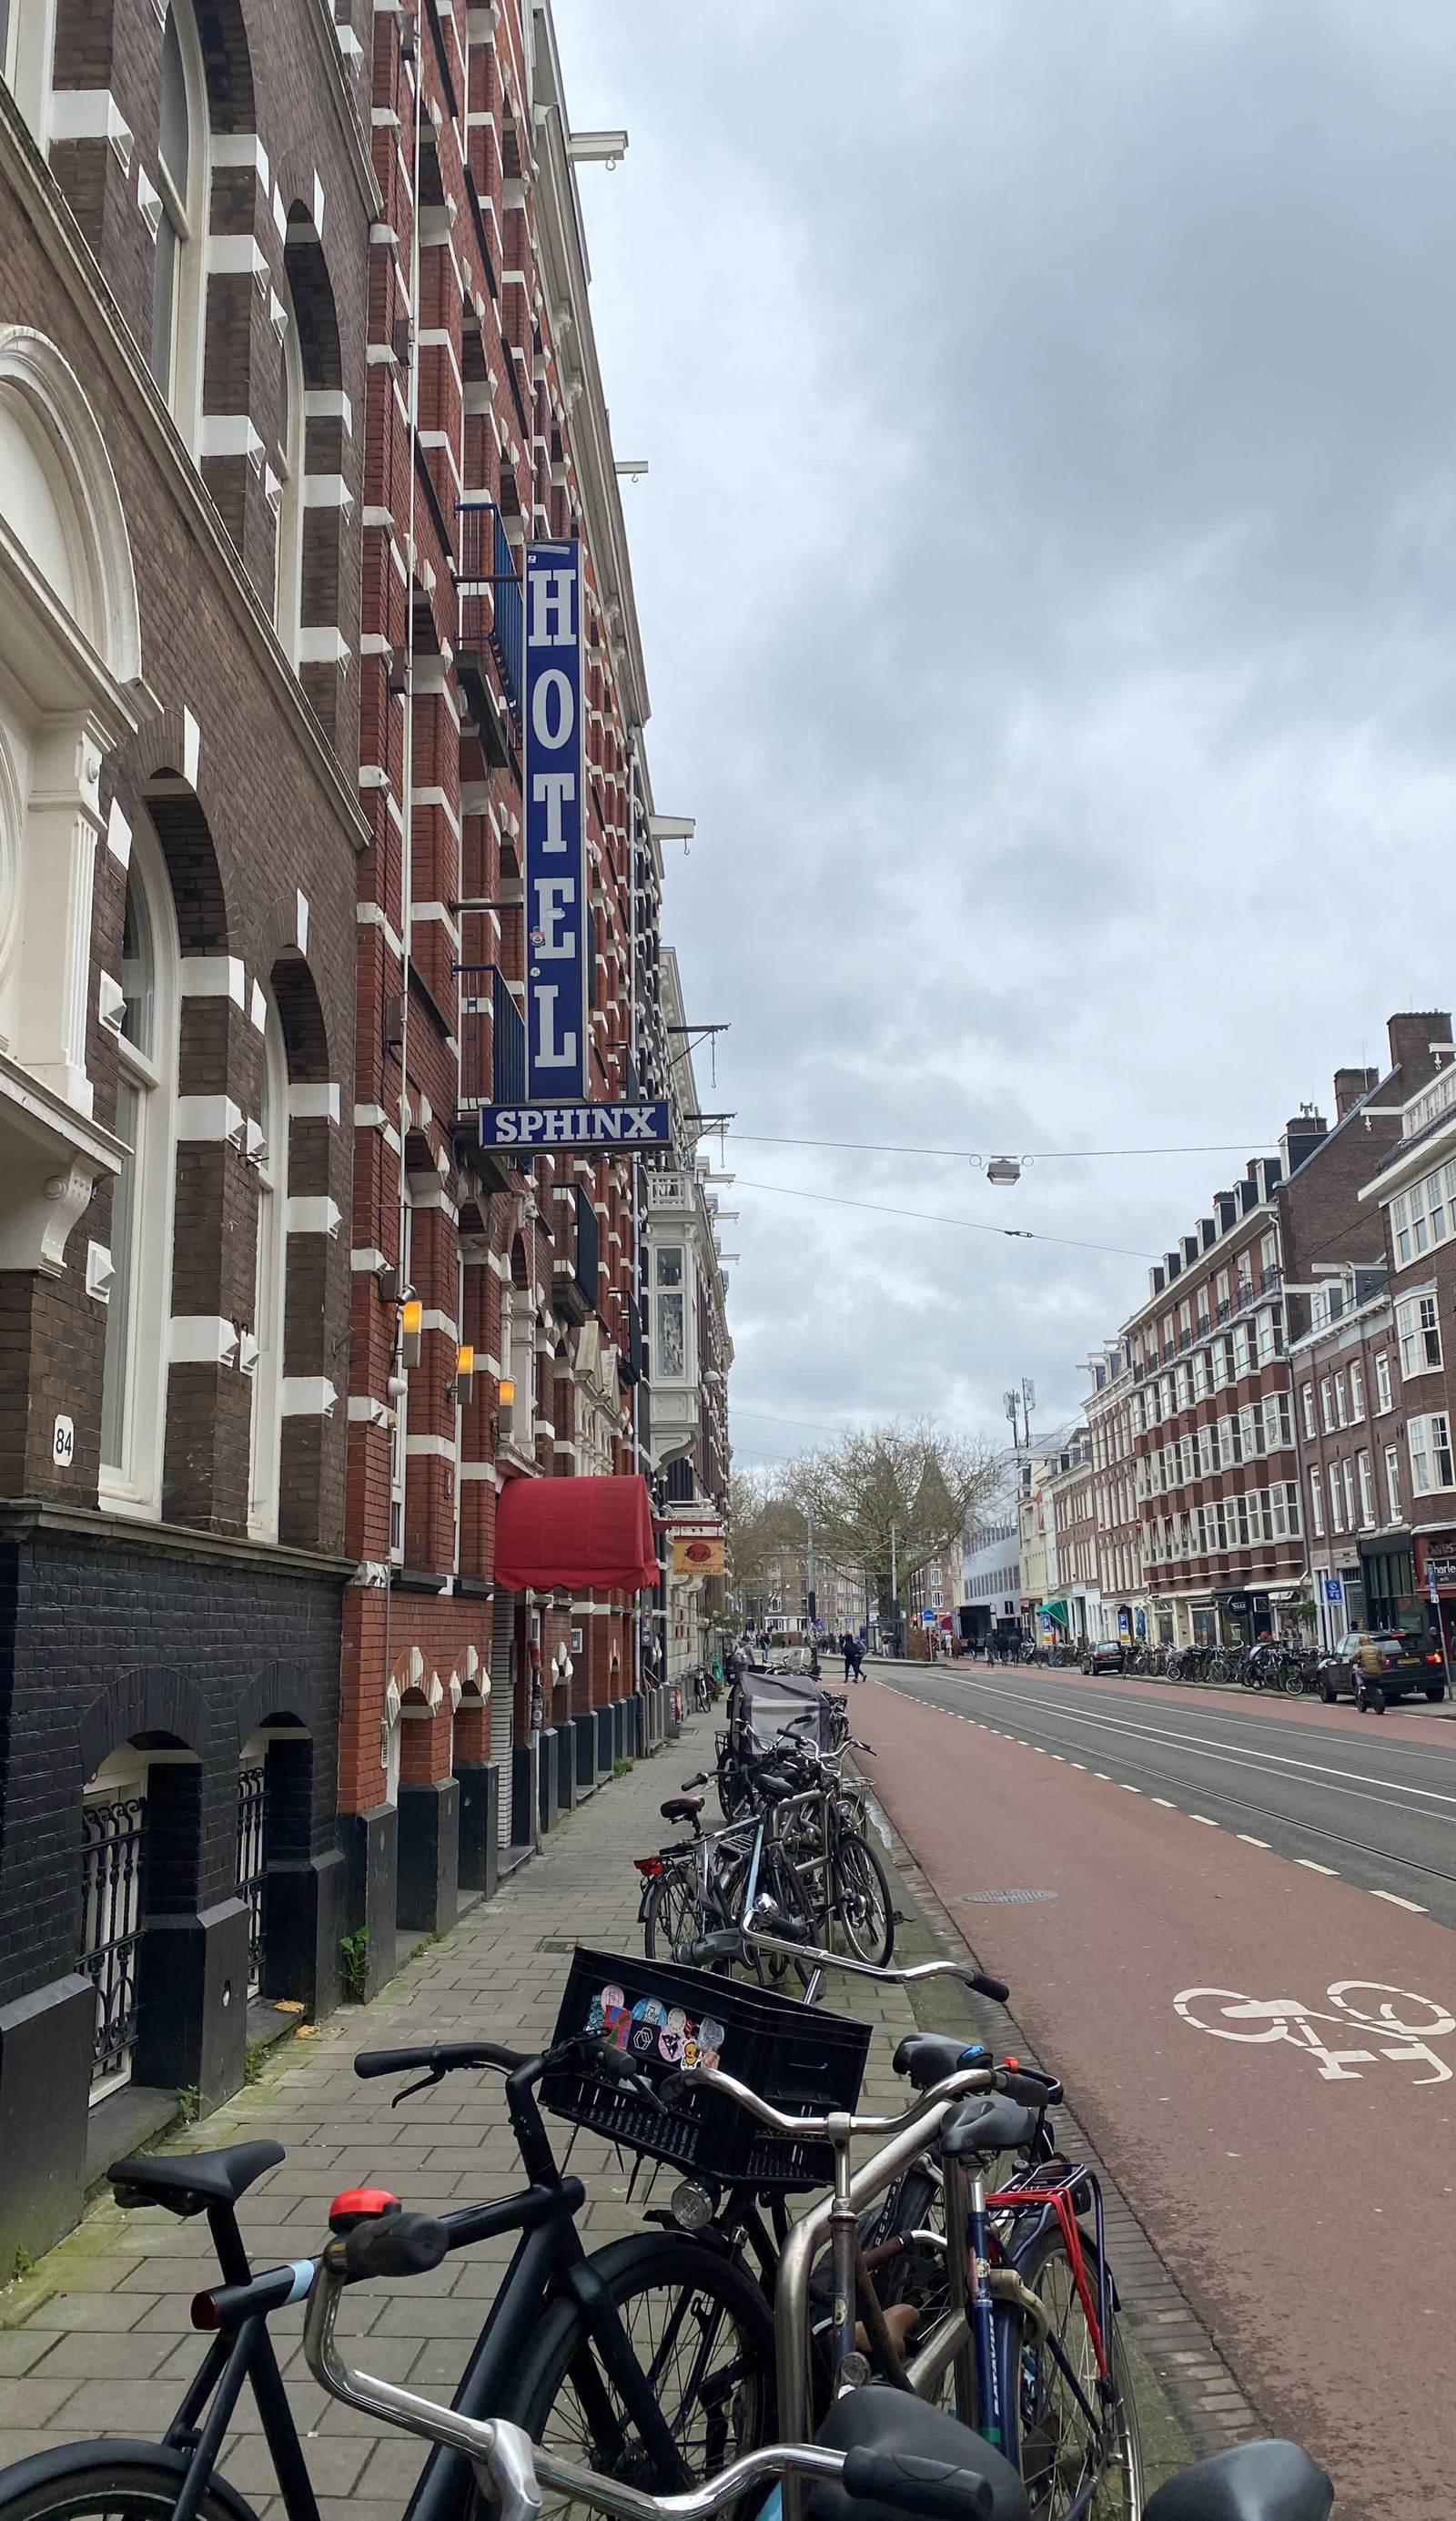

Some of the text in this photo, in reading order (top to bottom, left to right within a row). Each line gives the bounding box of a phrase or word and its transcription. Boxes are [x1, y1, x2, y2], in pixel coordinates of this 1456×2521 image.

[528, 569, 578, 1068] HOTEL
[495, 1107, 657, 1143] SPHINX
[56, 1428, 72, 1456] 84
